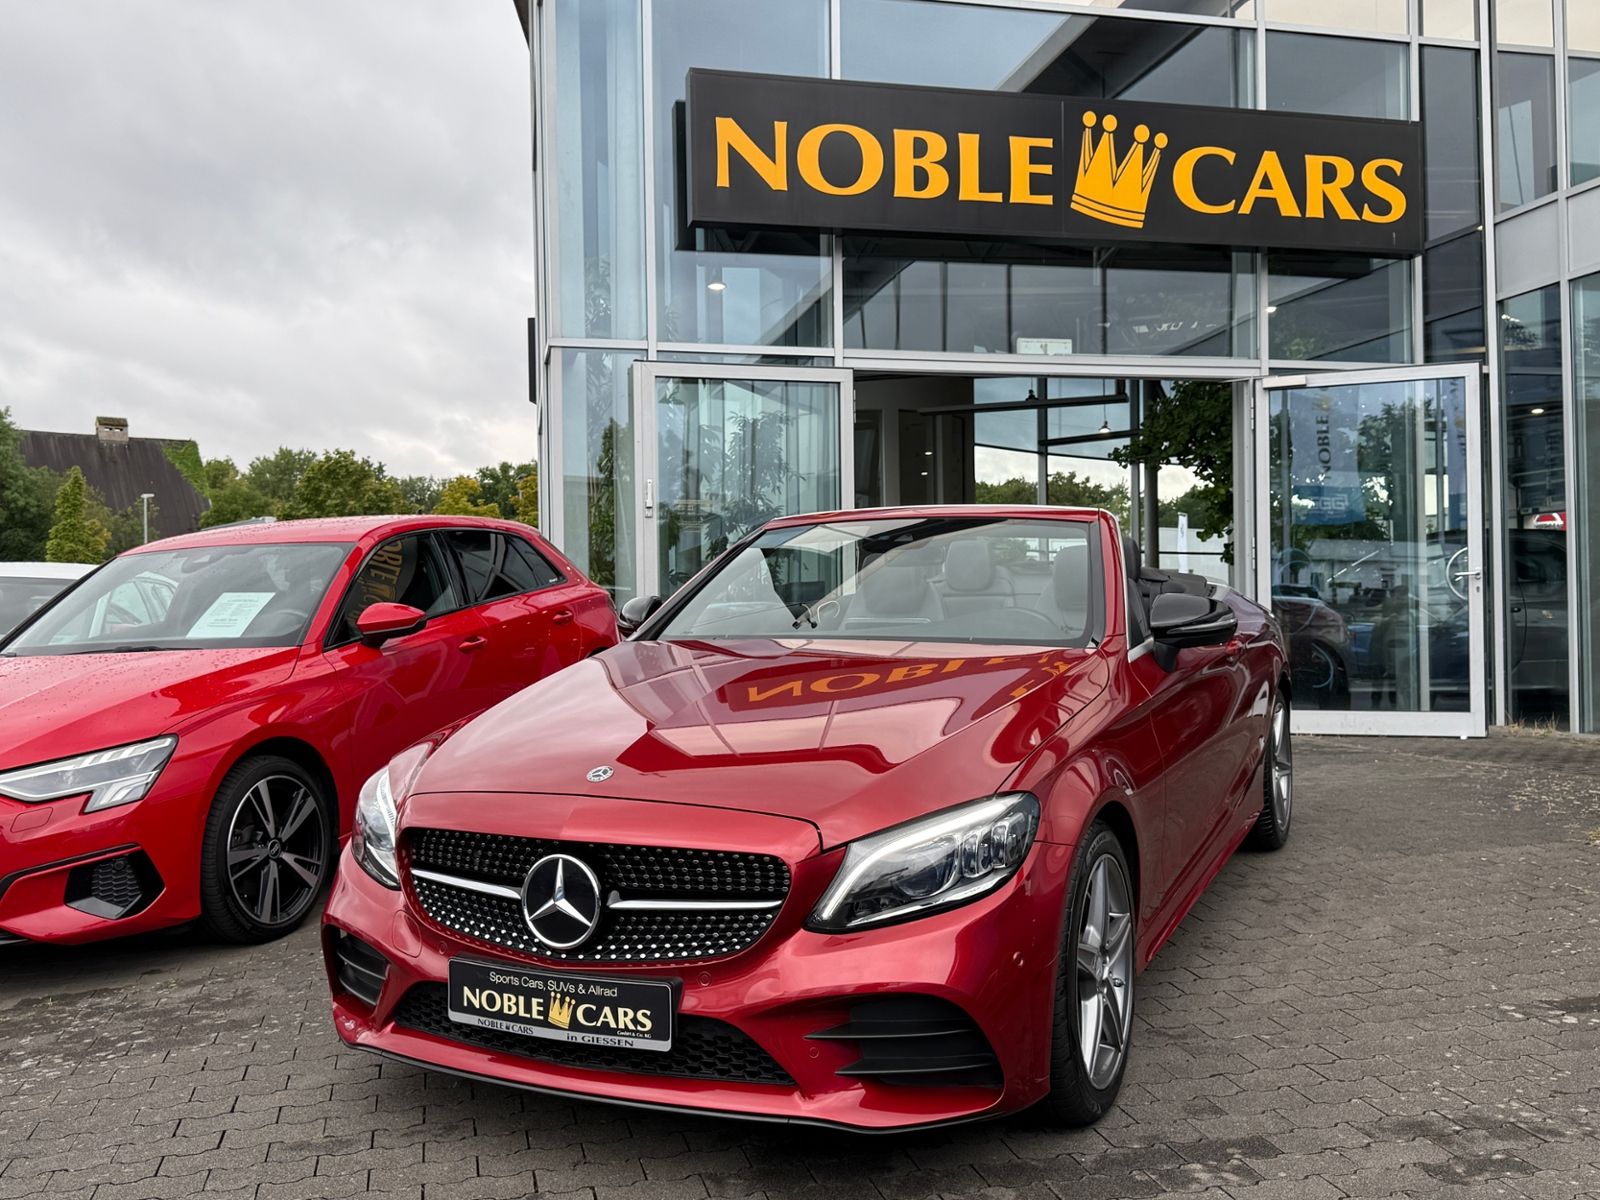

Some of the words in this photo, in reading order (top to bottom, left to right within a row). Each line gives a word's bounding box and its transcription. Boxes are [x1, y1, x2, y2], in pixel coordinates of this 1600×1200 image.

[715, 115, 1054, 206] NOBLE
[1172, 145, 1408, 224] CARS
[489, 971, 520, 986] Sports
[521, 976, 546, 992] Cars,
[547, 979, 576, 994] SUVs
[577, 983, 586, 995] &
[587, 985, 618, 997] Allrad
[463, 985, 544, 1020] NOBLE
[576, 1003, 653, 1032] CARS
[477, 1018, 504, 1030] NOBLE
[511, 1025, 534, 1035] CARS
[566, 1033, 578, 1042] in
[582, 1035, 634, 1047] GIESSEN
